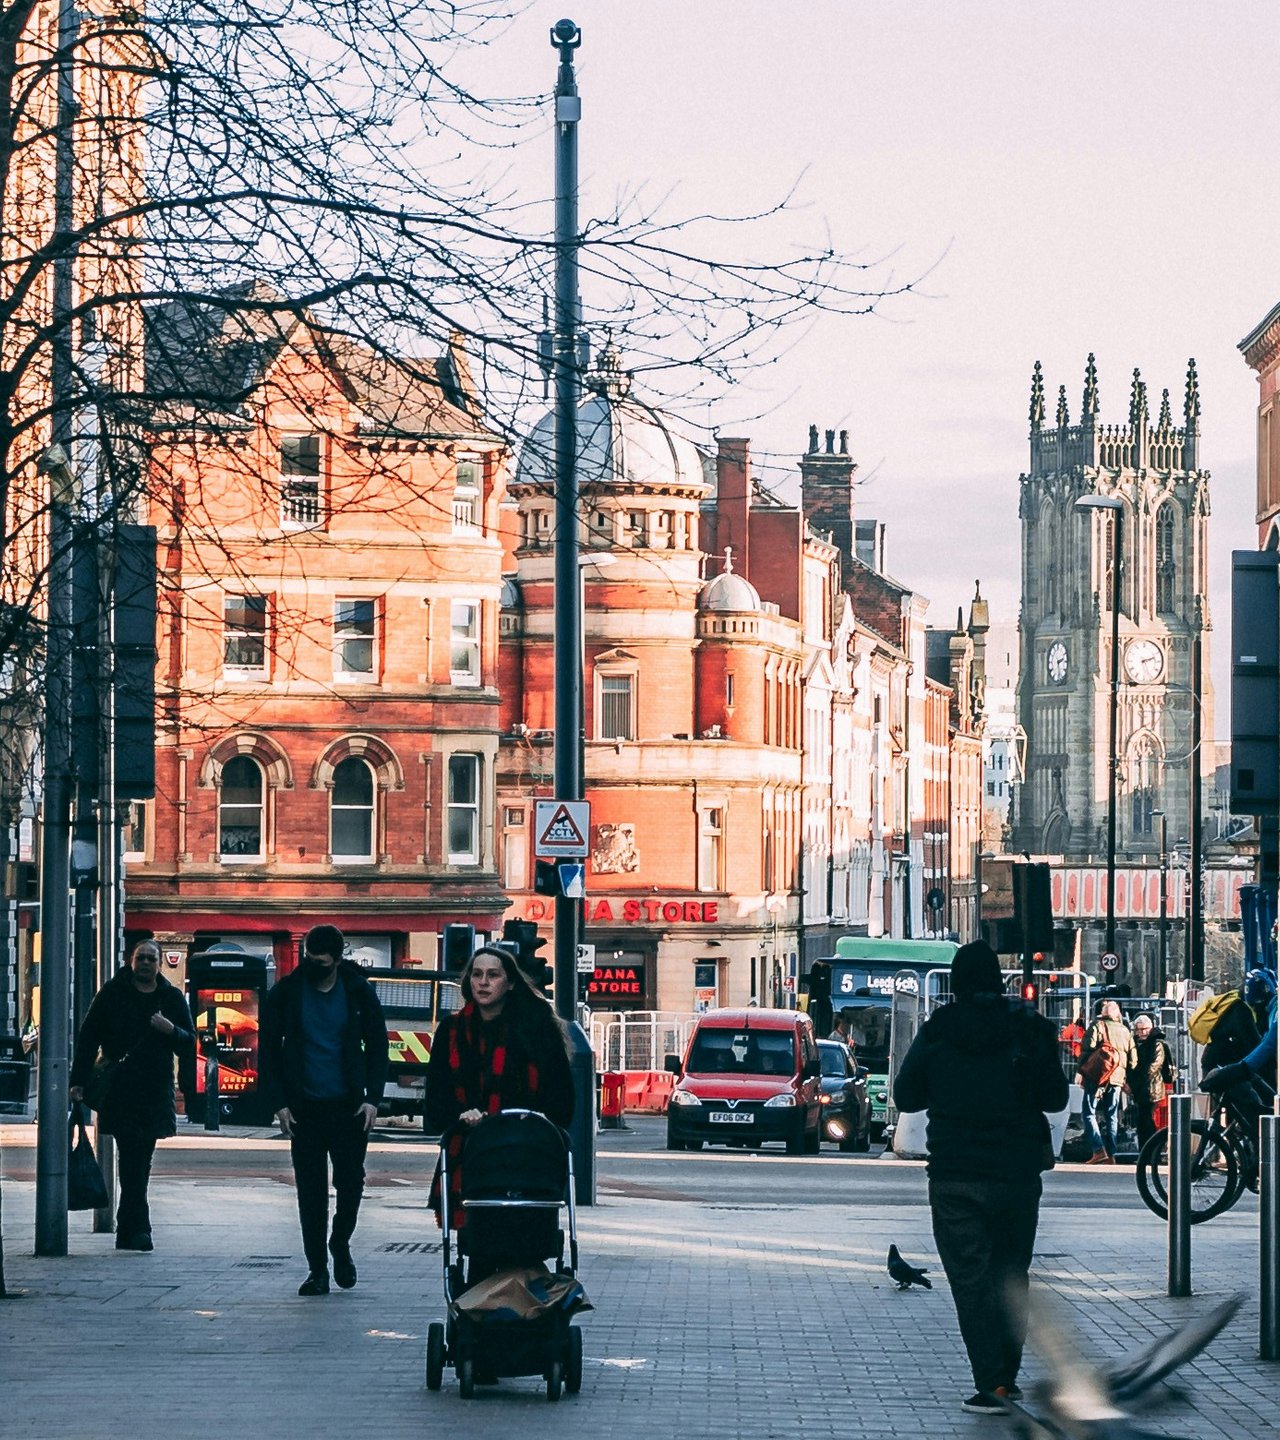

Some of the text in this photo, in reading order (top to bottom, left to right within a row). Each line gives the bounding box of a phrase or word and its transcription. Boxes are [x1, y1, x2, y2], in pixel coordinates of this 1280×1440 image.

[548, 827, 576, 836] CCTV
[622, 900, 719, 922] STORE
[1103, 957, 1117, 966] 20
[594, 968, 636, 980] DANA
[589, 982, 640, 992] STORE
[840, 973, 854, 993] 5
